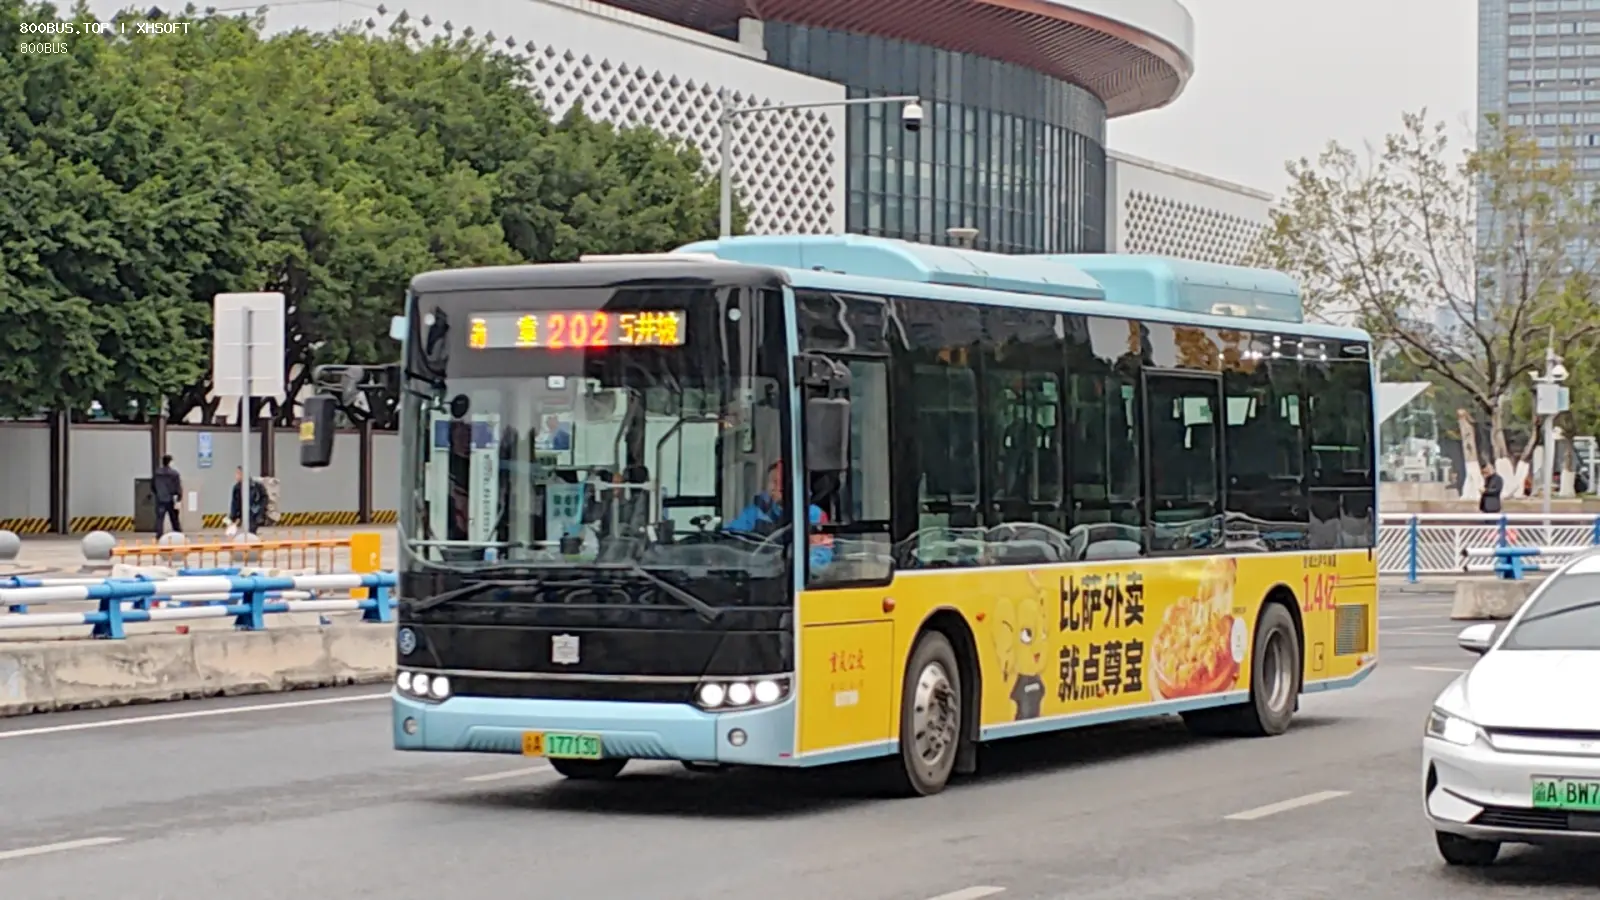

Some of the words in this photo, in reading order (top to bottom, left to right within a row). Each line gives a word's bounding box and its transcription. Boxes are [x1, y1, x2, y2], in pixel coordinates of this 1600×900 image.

[547, 311, 609, 349] 202
[1058, 571, 1145, 633] 比萨外卖
[1057, 637, 1145, 703] 就点尊宝
